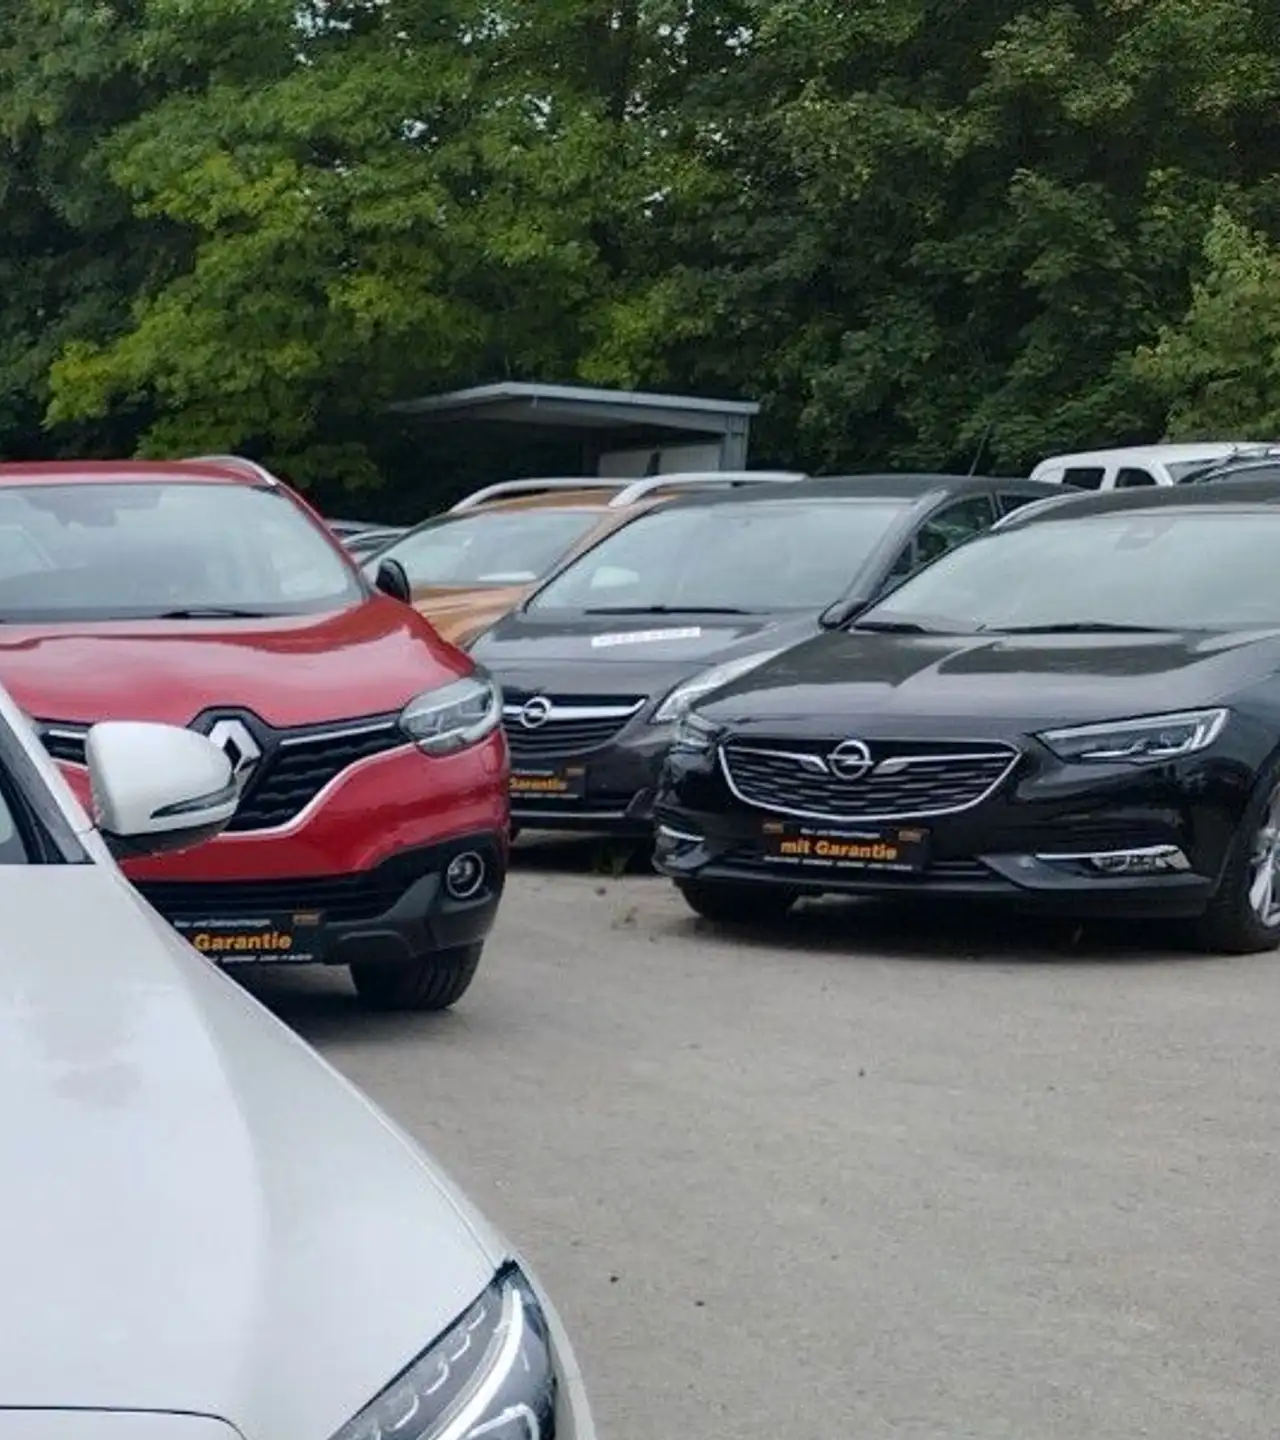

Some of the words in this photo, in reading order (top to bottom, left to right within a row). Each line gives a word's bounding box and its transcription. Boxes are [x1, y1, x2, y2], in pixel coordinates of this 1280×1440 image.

[780, 839, 810, 855] mit
[814, 840, 897, 861] Garantie
[194, 932, 292, 950] Garantie
